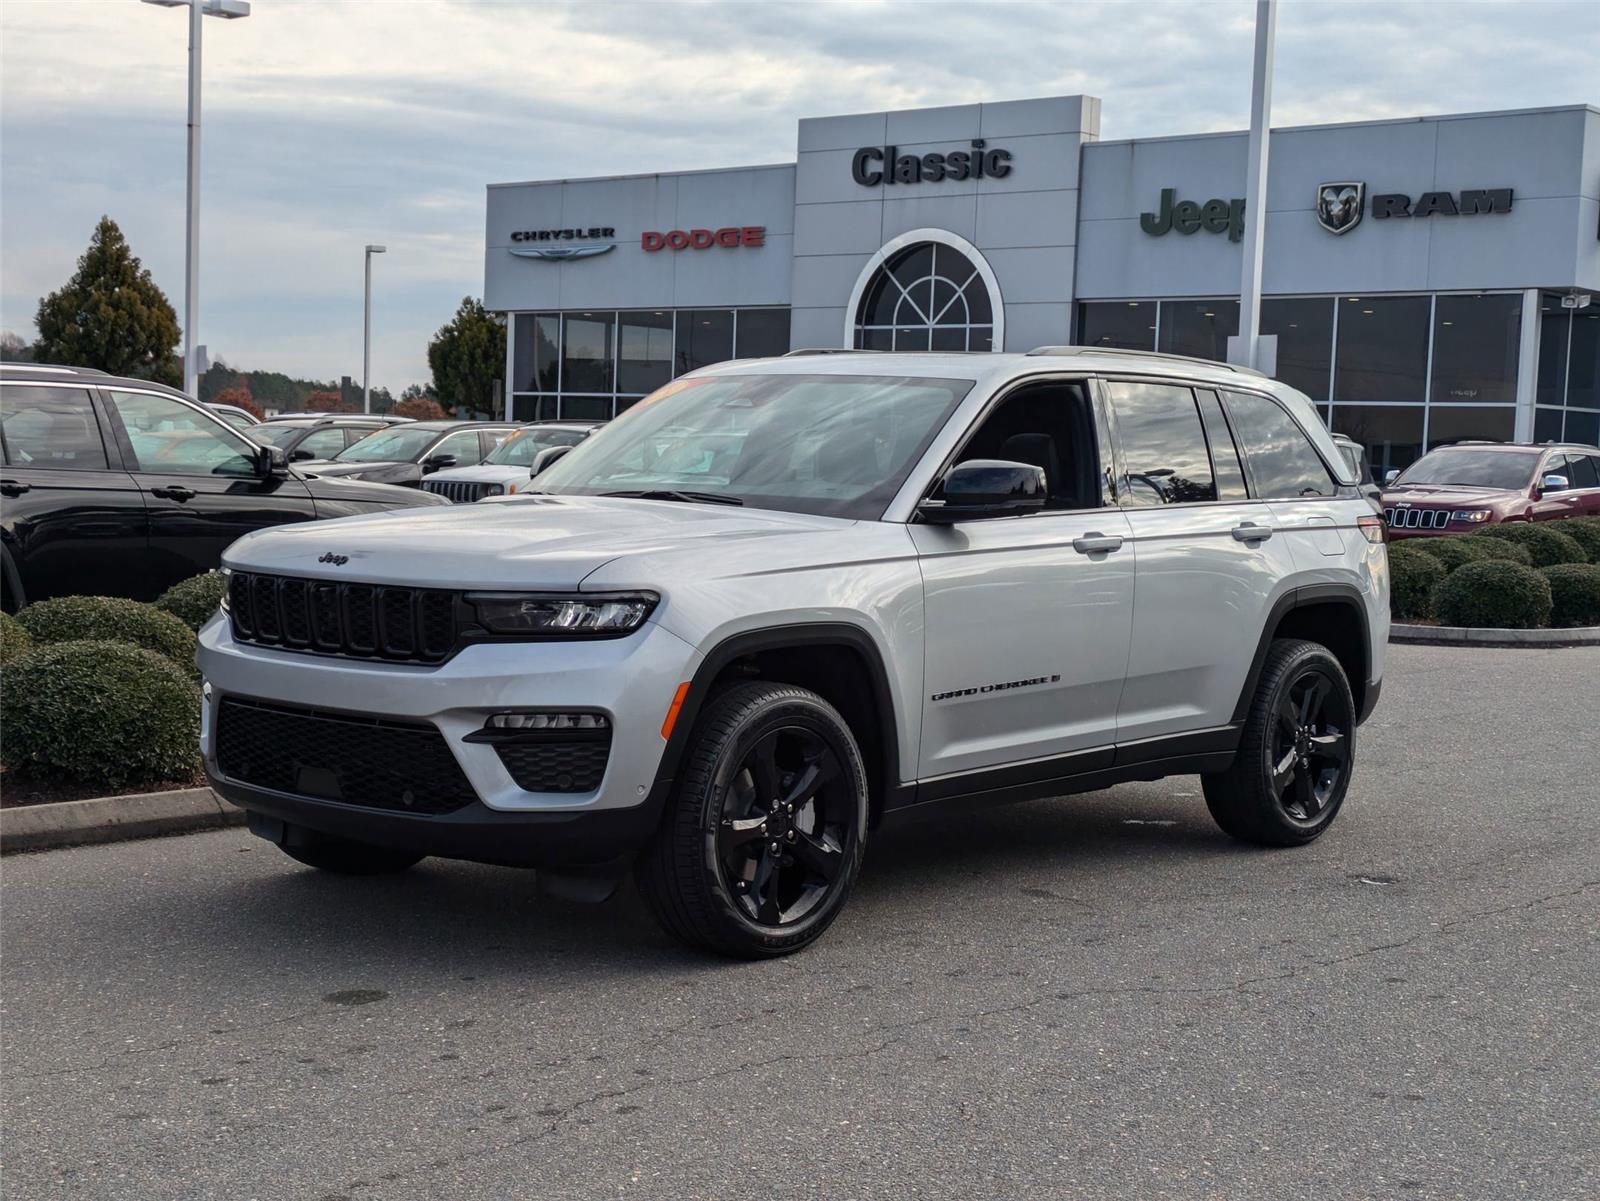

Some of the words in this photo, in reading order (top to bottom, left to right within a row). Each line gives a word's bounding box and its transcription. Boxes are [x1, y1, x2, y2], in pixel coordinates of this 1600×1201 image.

[852, 139, 1012, 187] Classic
[1371, 188, 1514, 219] RAM
[510, 227, 616, 242] CHRYSLER
[641, 226, 766, 252] DODGE
[318, 551, 349, 566] Jeep
[932, 687, 978, 701] GRAND
[980, 677, 1049, 693] CHEROKEE
